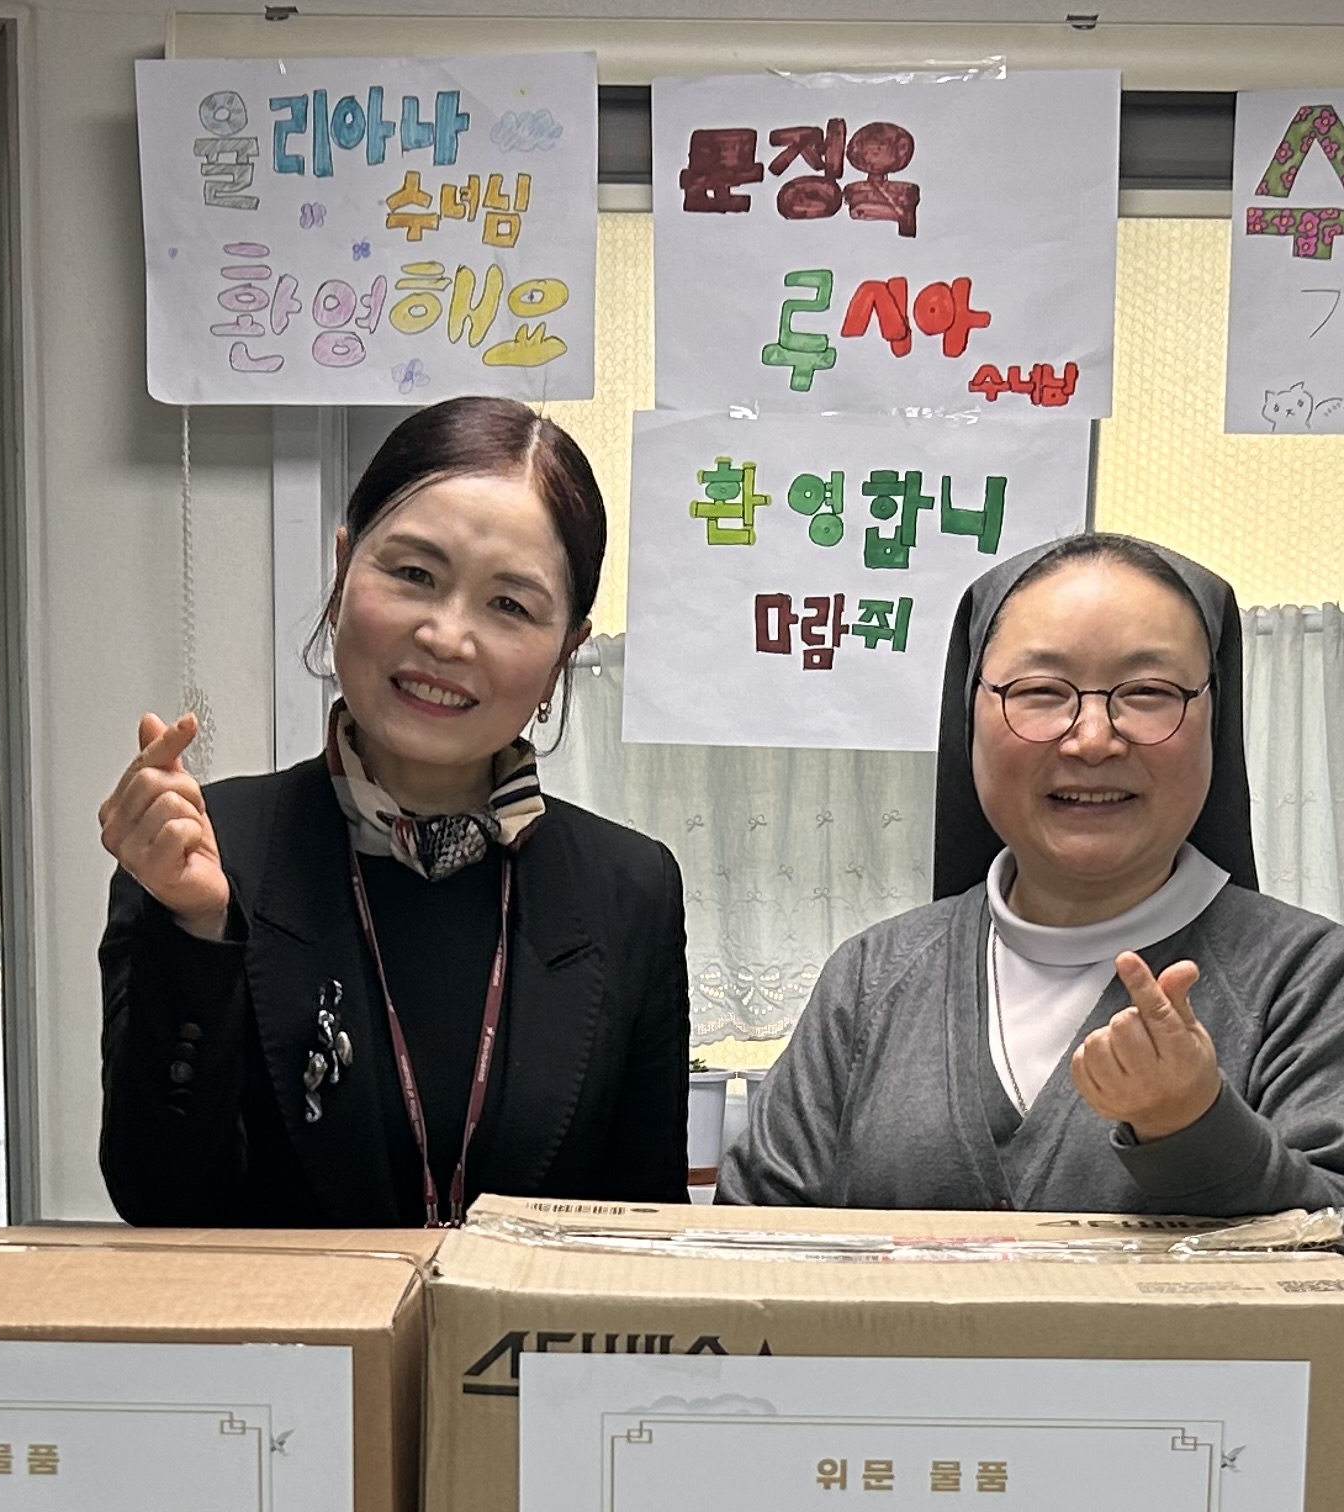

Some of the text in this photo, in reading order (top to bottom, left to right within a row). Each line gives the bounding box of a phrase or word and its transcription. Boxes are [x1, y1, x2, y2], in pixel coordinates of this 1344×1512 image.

[193, 86, 470, 210] 율리아나
[679, 118, 920, 238] 문정옥
[386, 171, 532, 248] 수녀님
[210, 242, 570, 373] 환영해요
[762, 269, 992, 392] 루시아
[968, 362, 1079, 407] 수녀님
[690, 456, 1007, 570] 환영합니
[815, 1457, 1009, 1492] 위문 물품
